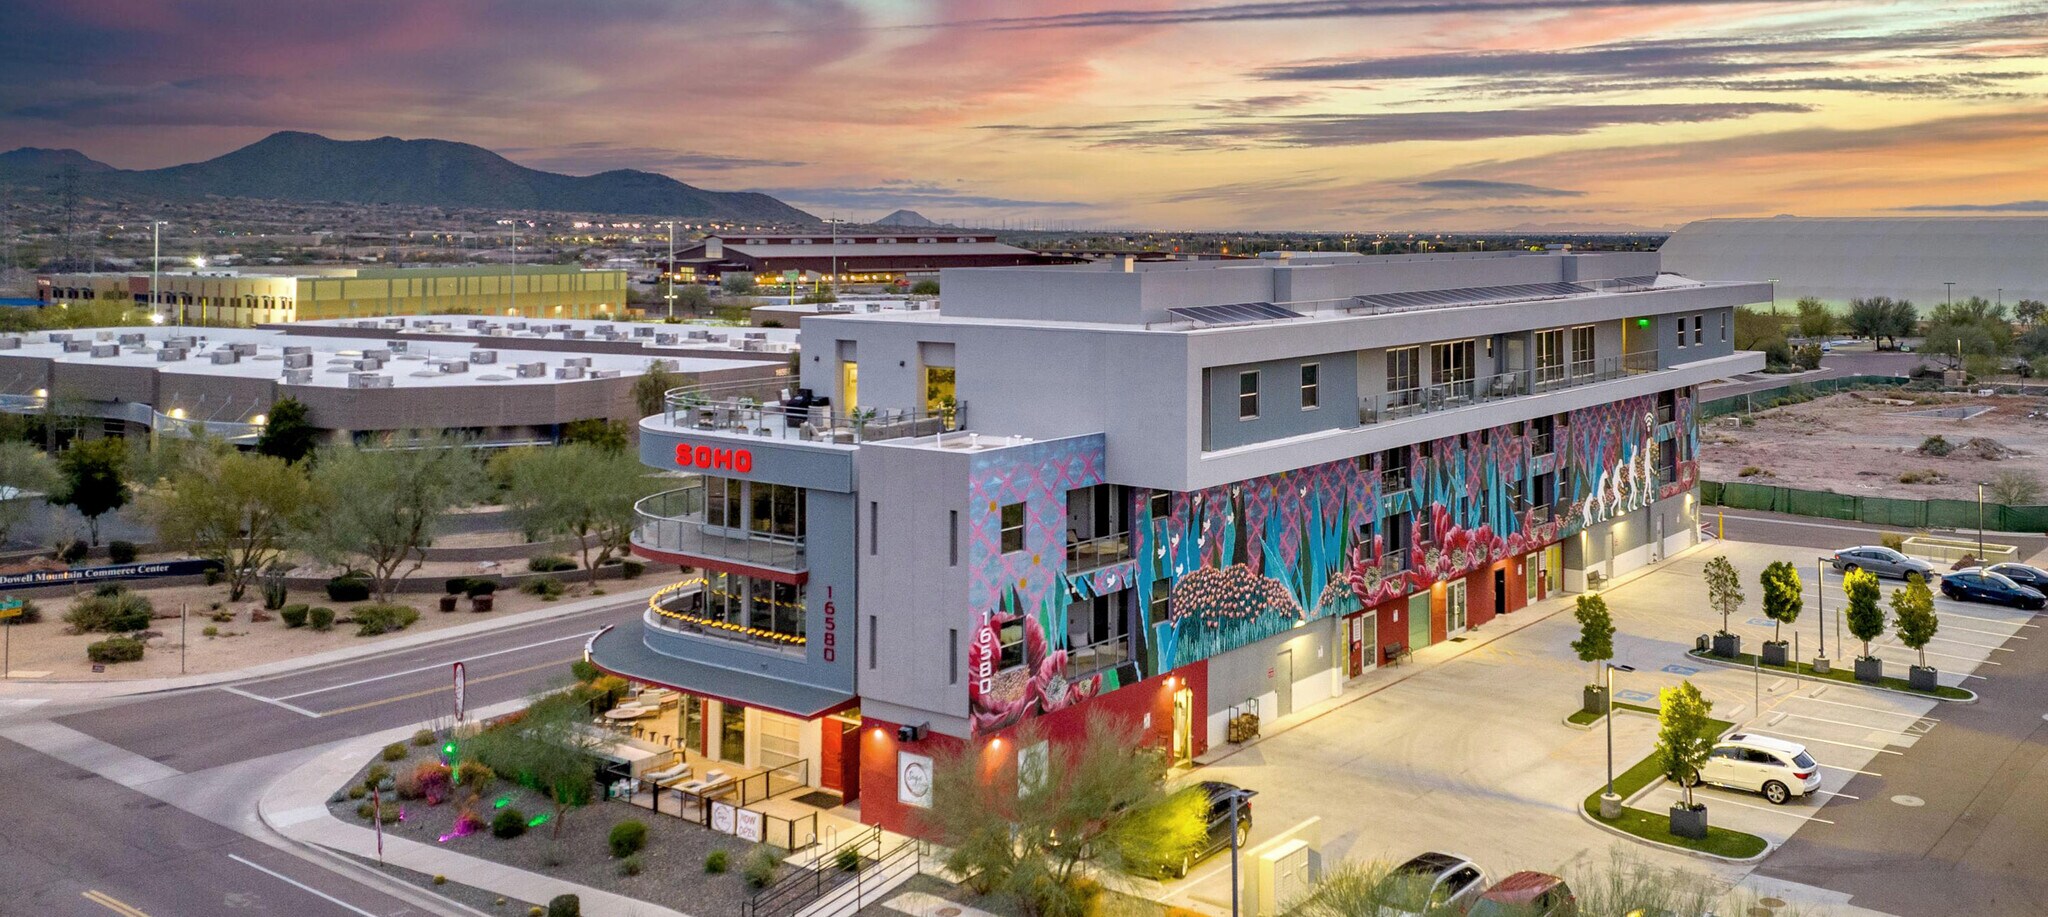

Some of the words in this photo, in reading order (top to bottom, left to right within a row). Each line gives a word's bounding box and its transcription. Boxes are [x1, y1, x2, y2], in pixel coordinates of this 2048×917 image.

[675, 443, 752, 473] SOHO
[35, 571, 83, 581] Mountain
[85, 567, 136, 578] Commerce
[137, 564, 170, 574] Center
[824, 585, 835, 662] 16580
[980, 611, 991, 694] 16580
